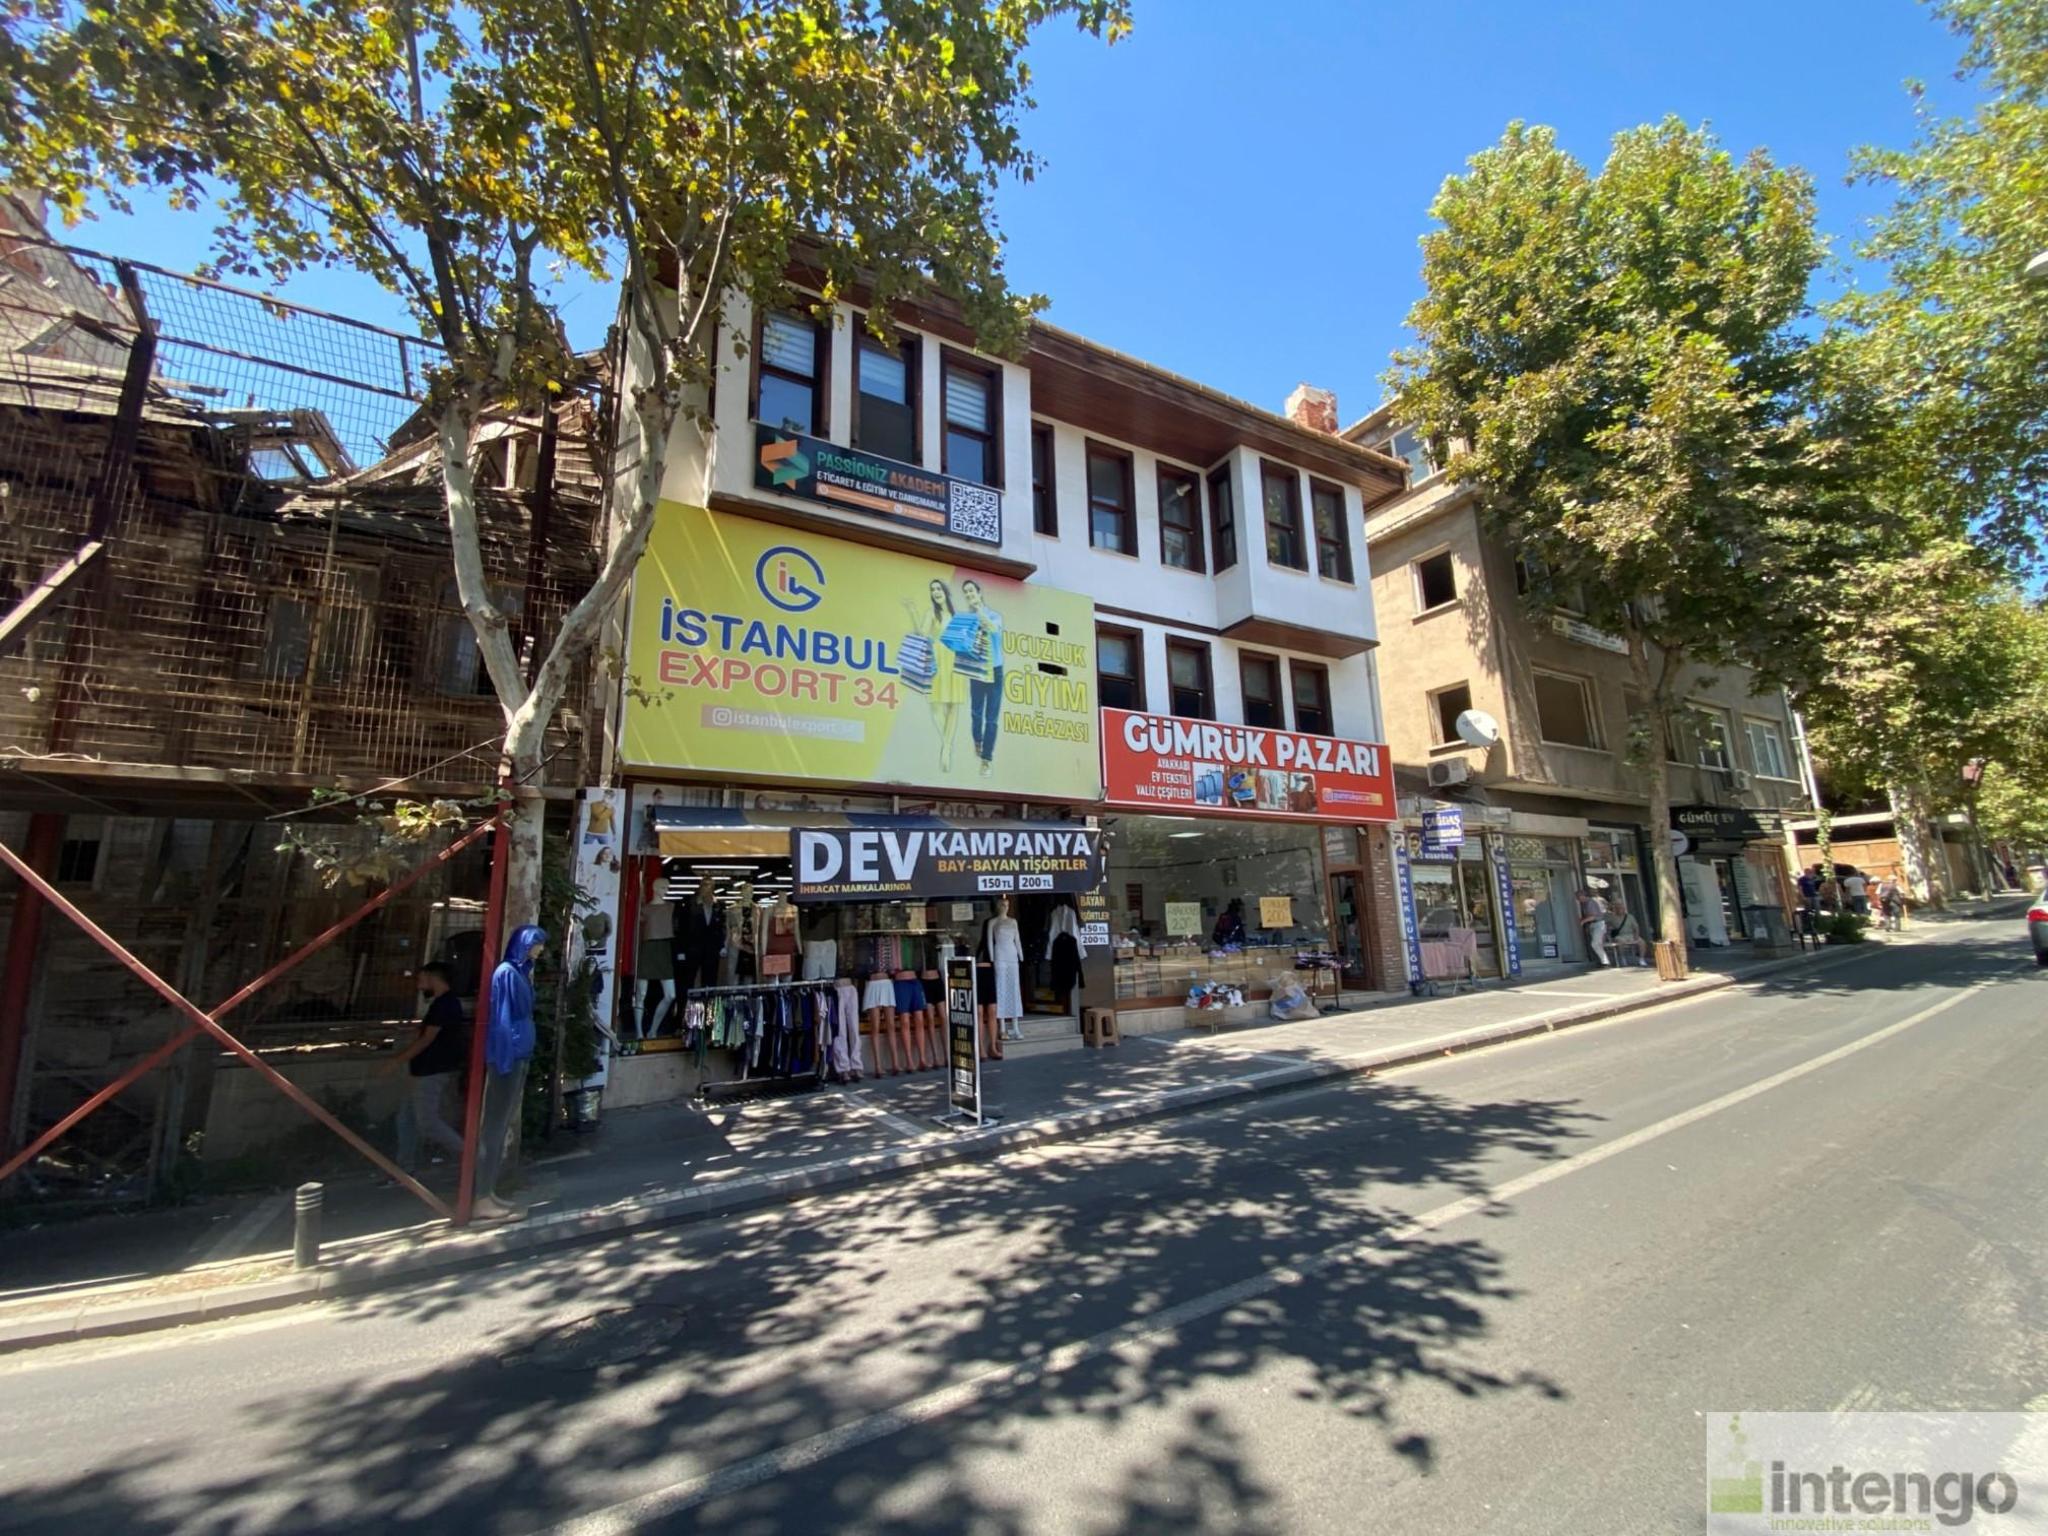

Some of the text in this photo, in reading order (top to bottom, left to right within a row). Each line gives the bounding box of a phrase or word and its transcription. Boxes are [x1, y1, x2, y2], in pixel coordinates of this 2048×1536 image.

[889, 471, 946, 499] AKADEMİ
[660, 597, 900, 676] İSTANBUL
[1002, 631, 1087, 668] UCUZLUK
[659, 649, 900, 711] EXPORT 34
[1004, 664, 1089, 714] GİYİM
[1003, 711, 1089, 744] MAĞAZASI
[1123, 714, 1381, 778] GÜMRÜK PAZARI
[1135, 783, 1156, 797] VALİZ
[800, 831, 1092, 883] DEV KAMPANYA
[1023, 856, 1089, 874] TİŞÖRTLER
[800, 882, 913, 894] İHRACAT MARKALARINDA
[981, 878, 1013, 889] 150 TL
[1022, 877, 1053, 888] 200 TL
[1080, 896, 1106, 907] BAYAN
[1082, 936, 1099, 944] 200
[951, 988, 973, 1012] DEV
